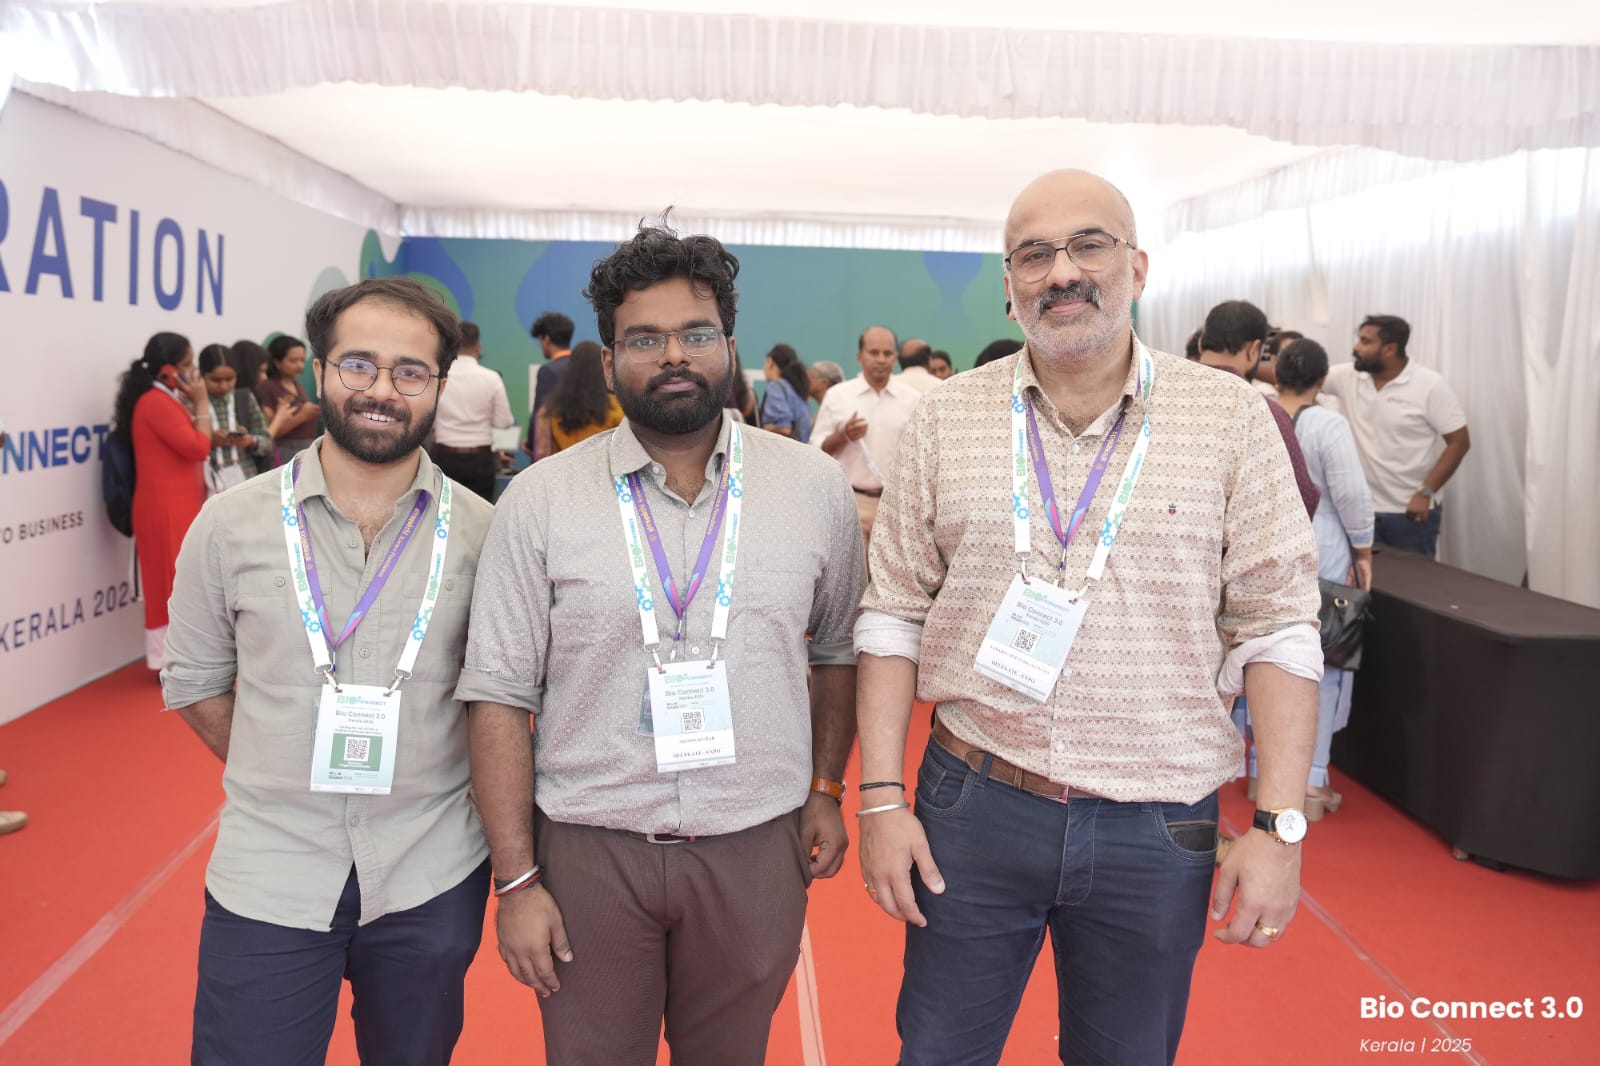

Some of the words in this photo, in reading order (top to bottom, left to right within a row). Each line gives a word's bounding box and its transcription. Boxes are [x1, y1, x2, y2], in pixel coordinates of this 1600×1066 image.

[0, 178, 224, 316] ATION
[19, 510, 83, 541] BUSINESS
[0, 597, 84, 652] KERALA
[93, 581, 137, 618] 202
[1016, 601, 1028, 611] Bio
[1027, 607, 1055, 622] Connect
